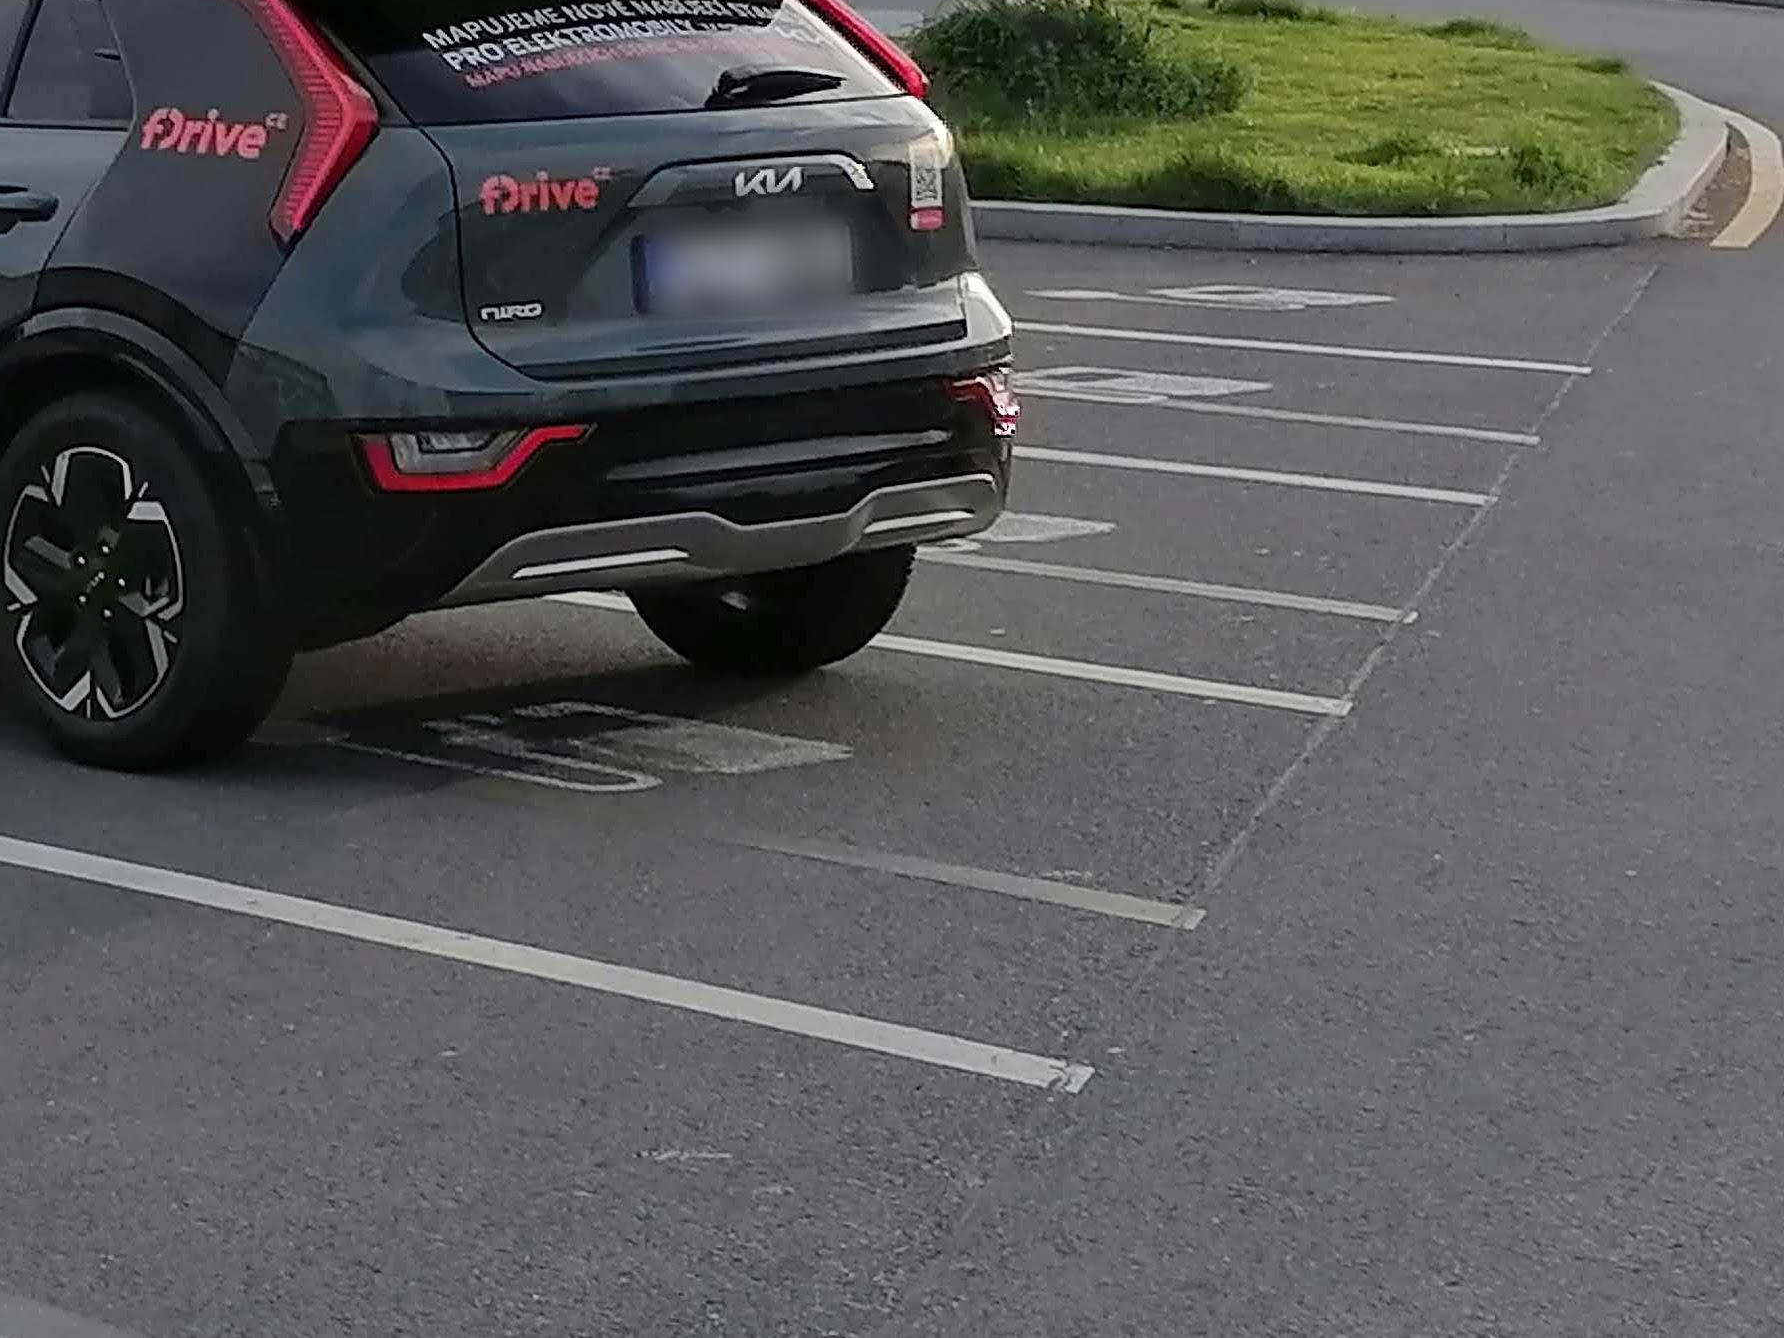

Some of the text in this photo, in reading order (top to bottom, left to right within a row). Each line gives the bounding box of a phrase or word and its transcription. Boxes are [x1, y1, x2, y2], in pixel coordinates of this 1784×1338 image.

[422, 7, 565, 49] MAPUJEME
[443, 43, 506, 72] PRO
[502, 18, 697, 57] ELEKTROMOBILY
